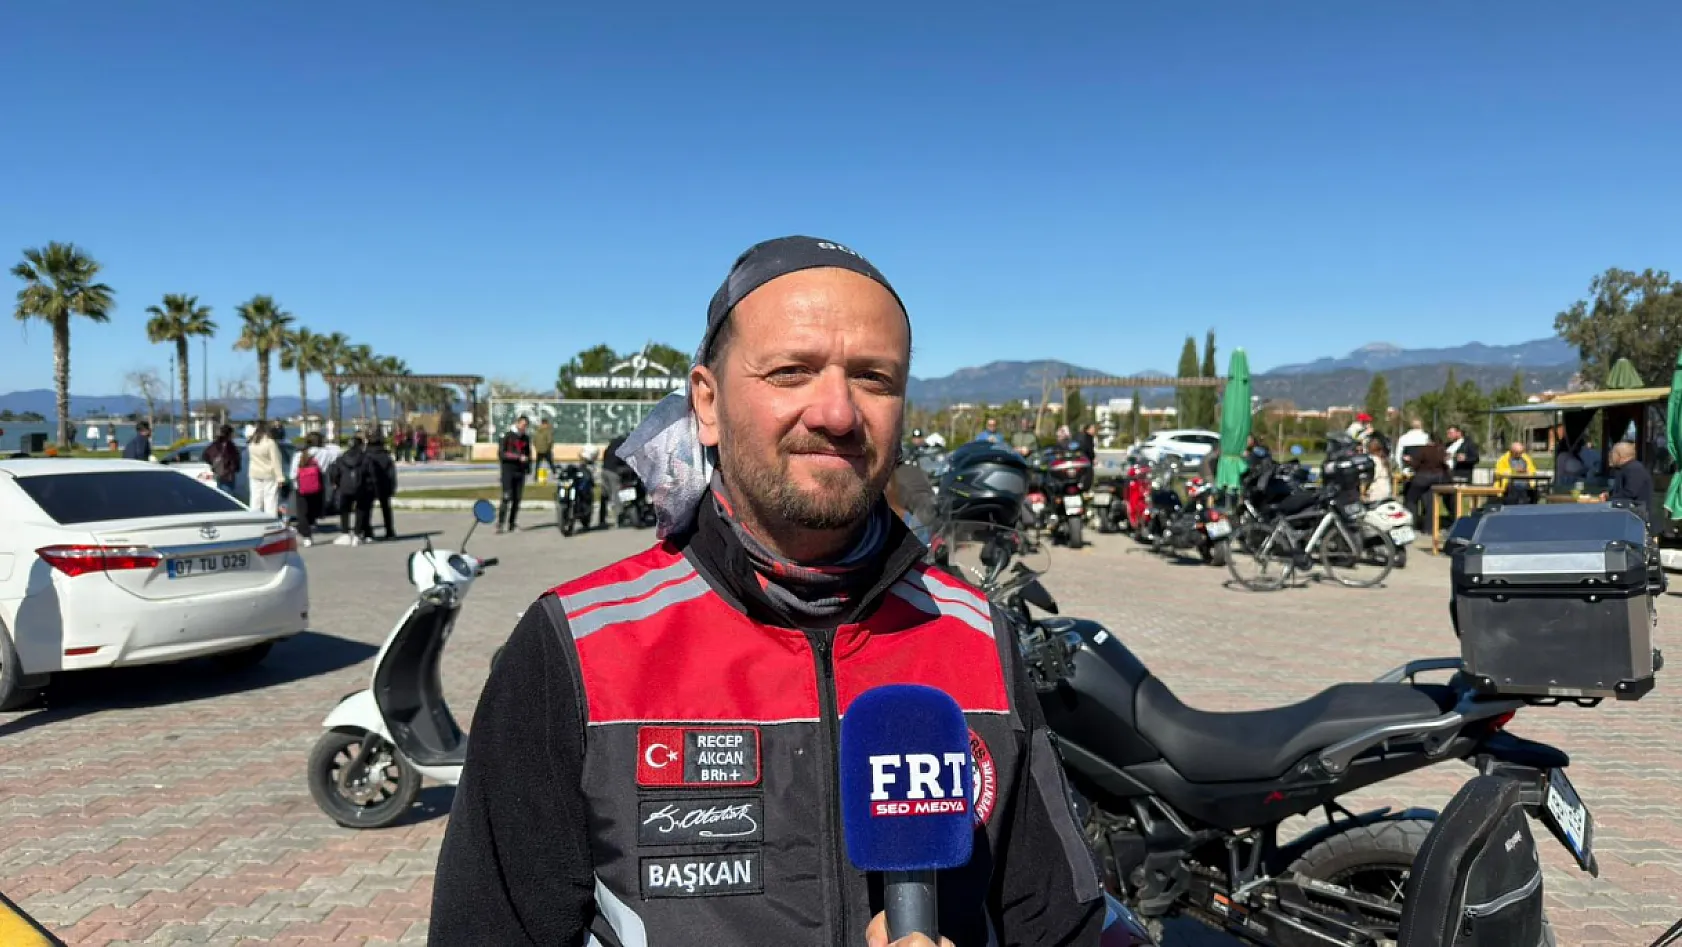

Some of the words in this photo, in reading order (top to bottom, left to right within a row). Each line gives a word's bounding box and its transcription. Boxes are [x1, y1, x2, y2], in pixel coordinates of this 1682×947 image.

[175, 559, 193, 575] 07
[199, 556, 217, 572] TU
[222, 554, 247, 569] 029
[697, 735, 743, 748] RECEP
[697, 751, 743, 766] AKCAN
[869, 752, 966, 800] FRT
[876, 803, 910, 815] SED
[915, 801, 965, 814] MEDYA
[648, 860, 751, 893] BAŞKAN
